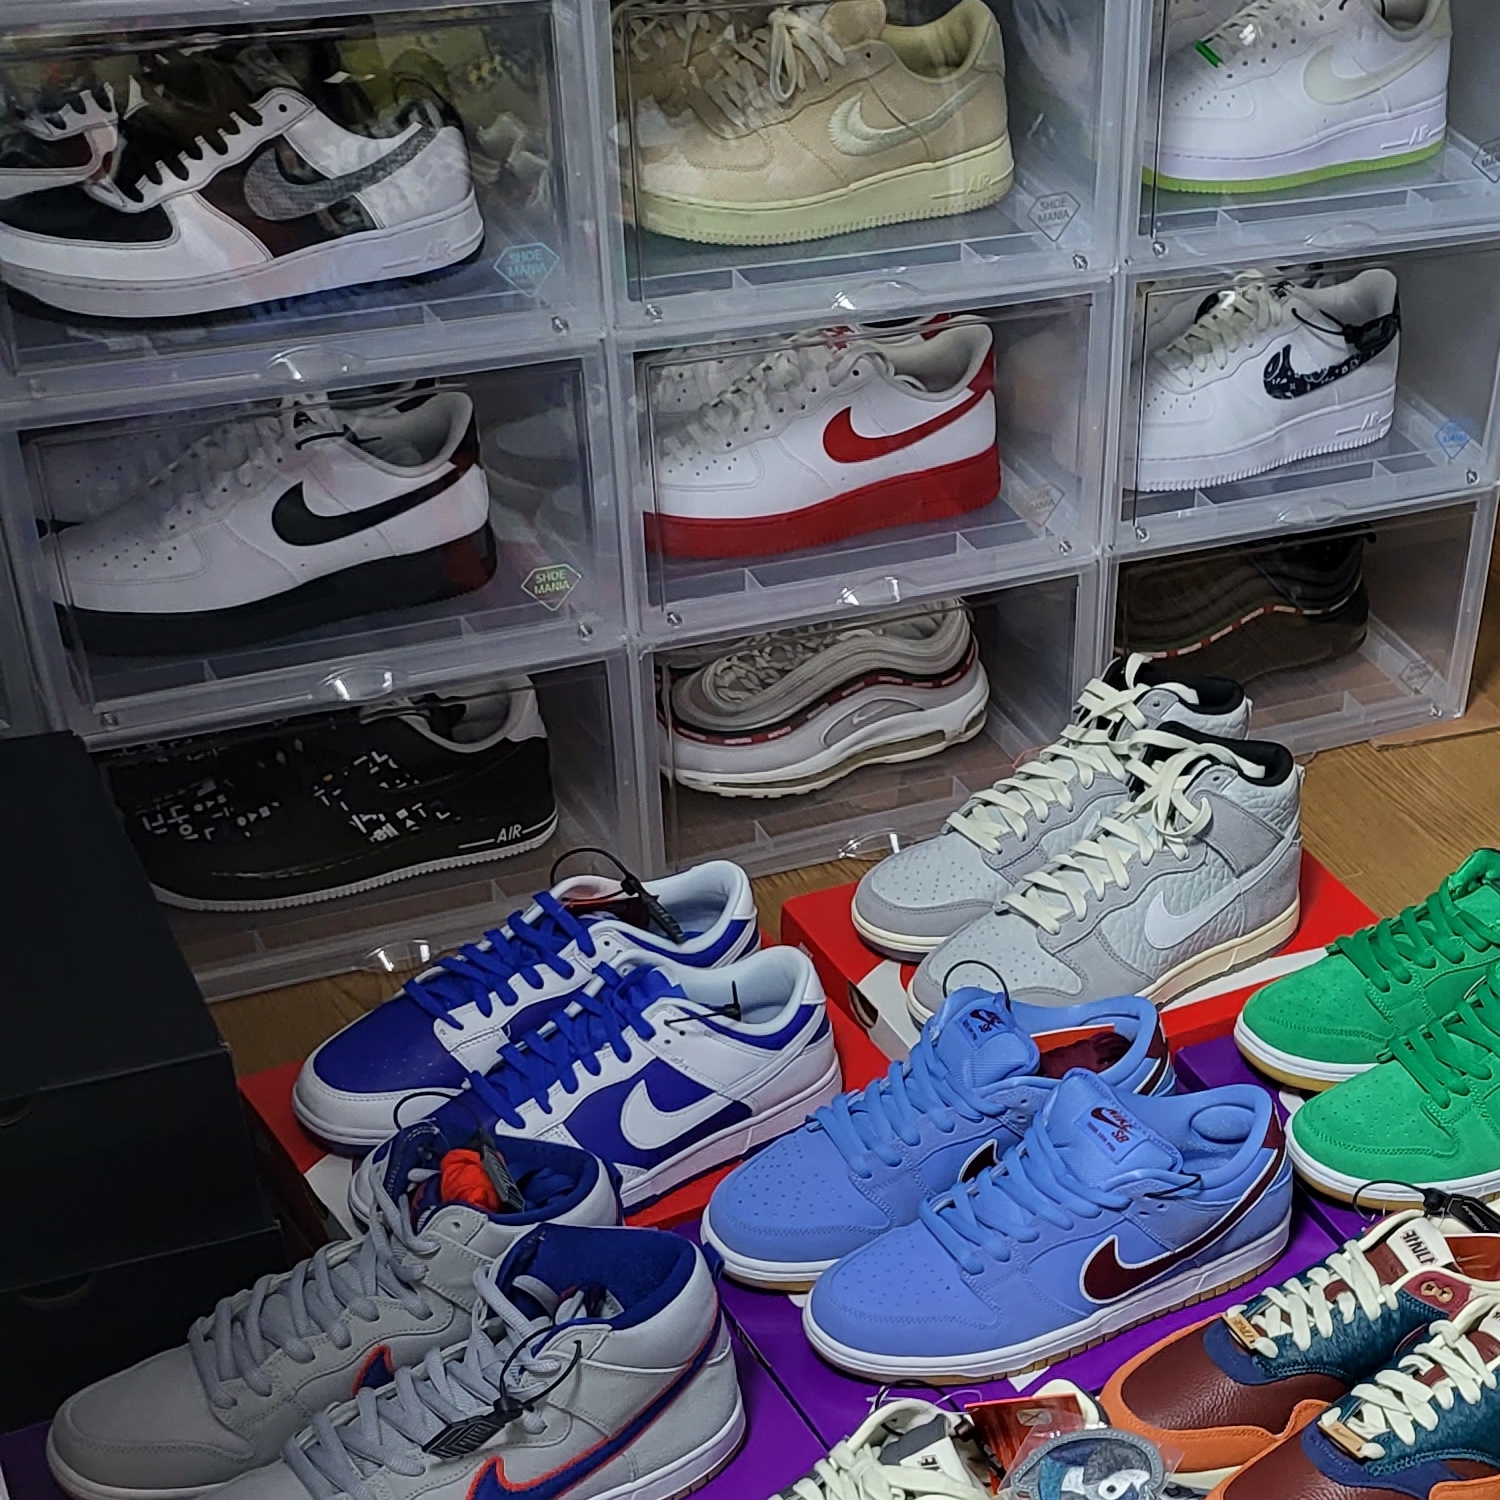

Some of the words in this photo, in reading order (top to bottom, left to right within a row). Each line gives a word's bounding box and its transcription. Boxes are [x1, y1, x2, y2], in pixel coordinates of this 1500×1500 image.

[1039, 198, 1067, 210] SHOE
[1038, 209, 1071, 223] MANIA
[536, 570, 566, 583] SHOE
[534, 580, 571, 595] MANIA
[496, 824, 523, 843] AIR
[1111, 1130, 1130, 1143] SB
